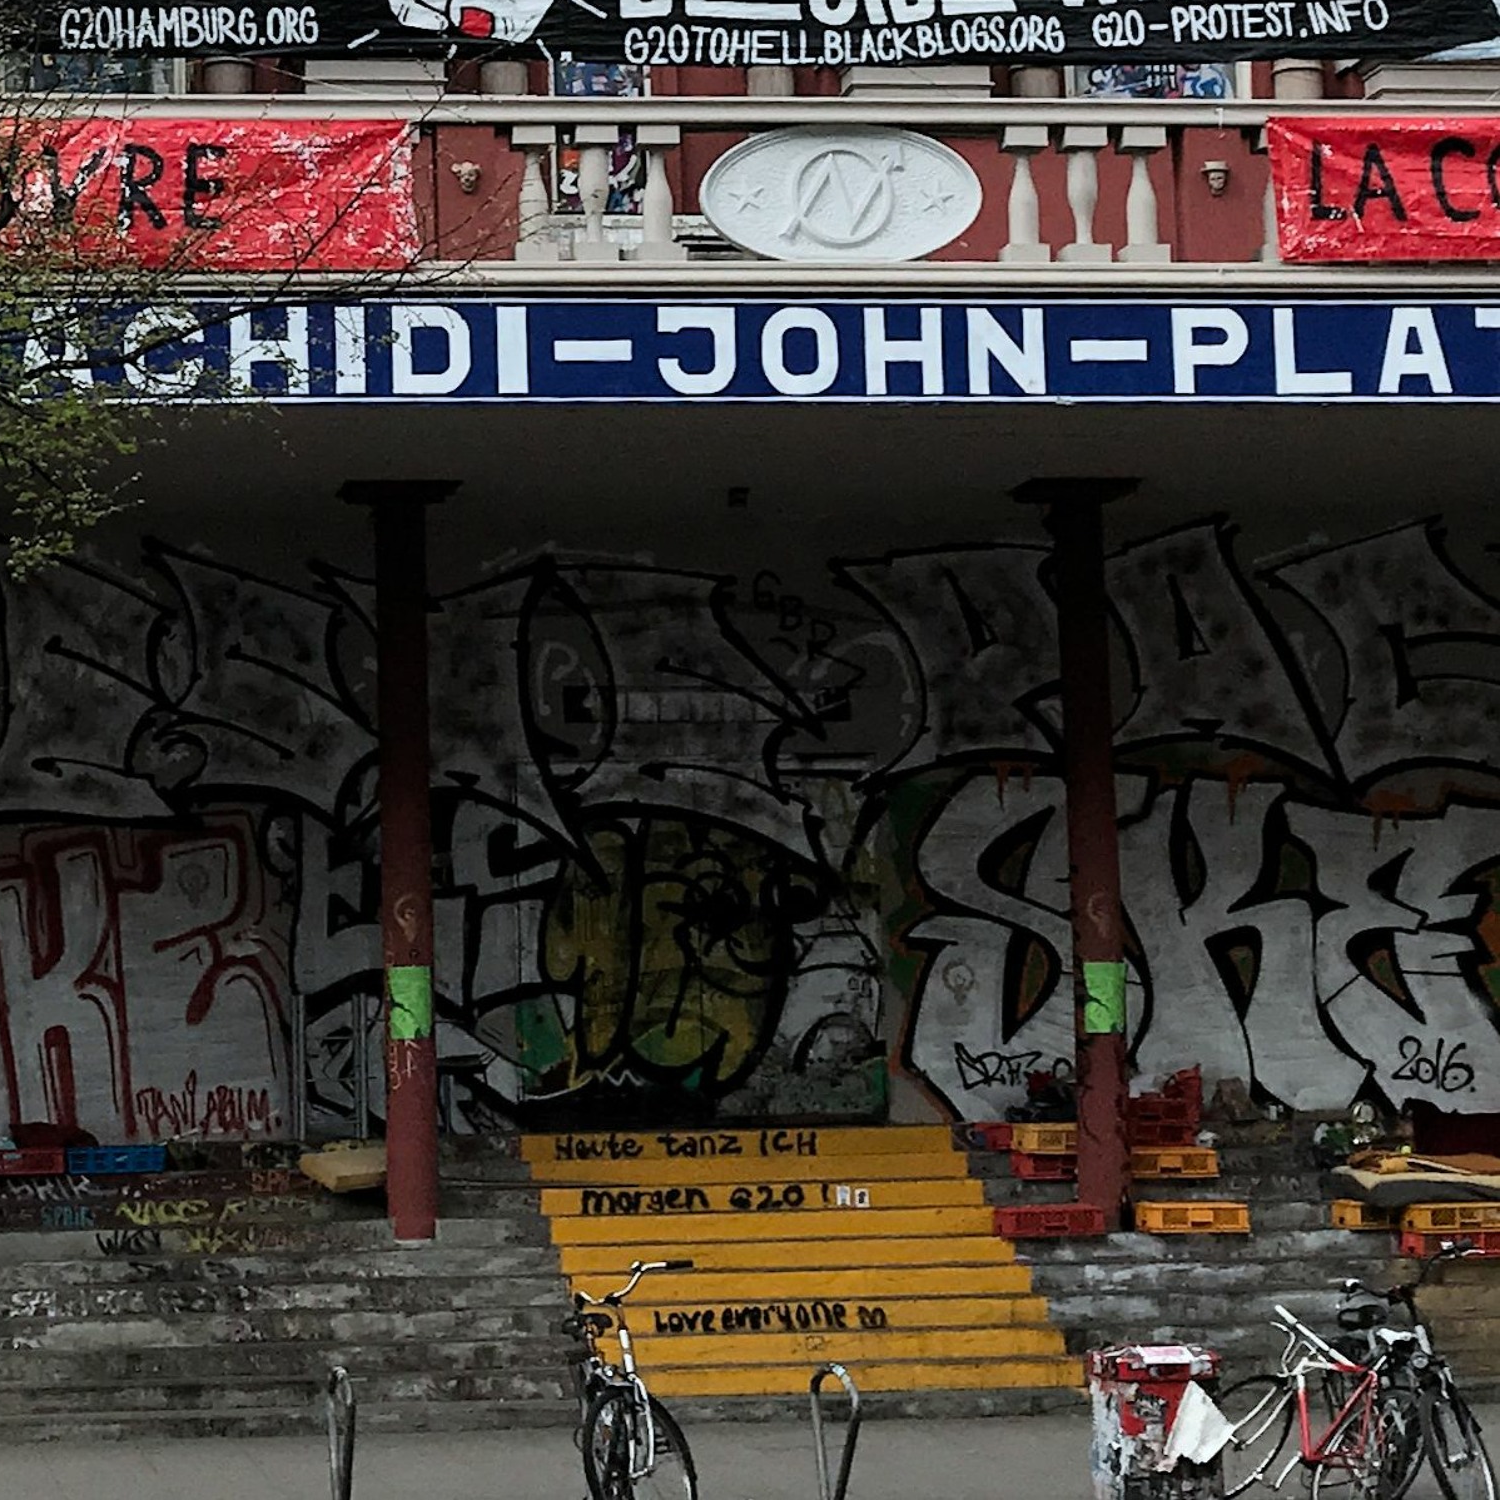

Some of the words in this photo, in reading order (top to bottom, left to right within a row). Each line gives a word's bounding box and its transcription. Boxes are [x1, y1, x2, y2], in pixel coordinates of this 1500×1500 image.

[59, 5, 320, 50] G20HAMBURG.ORG
[1308, 138, 1408, 223] LA
[1429, 135, 1500, 223] C
[18, 302, 1500, 398] ACHIDI-JOHN-PLA
[760, 1130, 818, 1157] ICH
